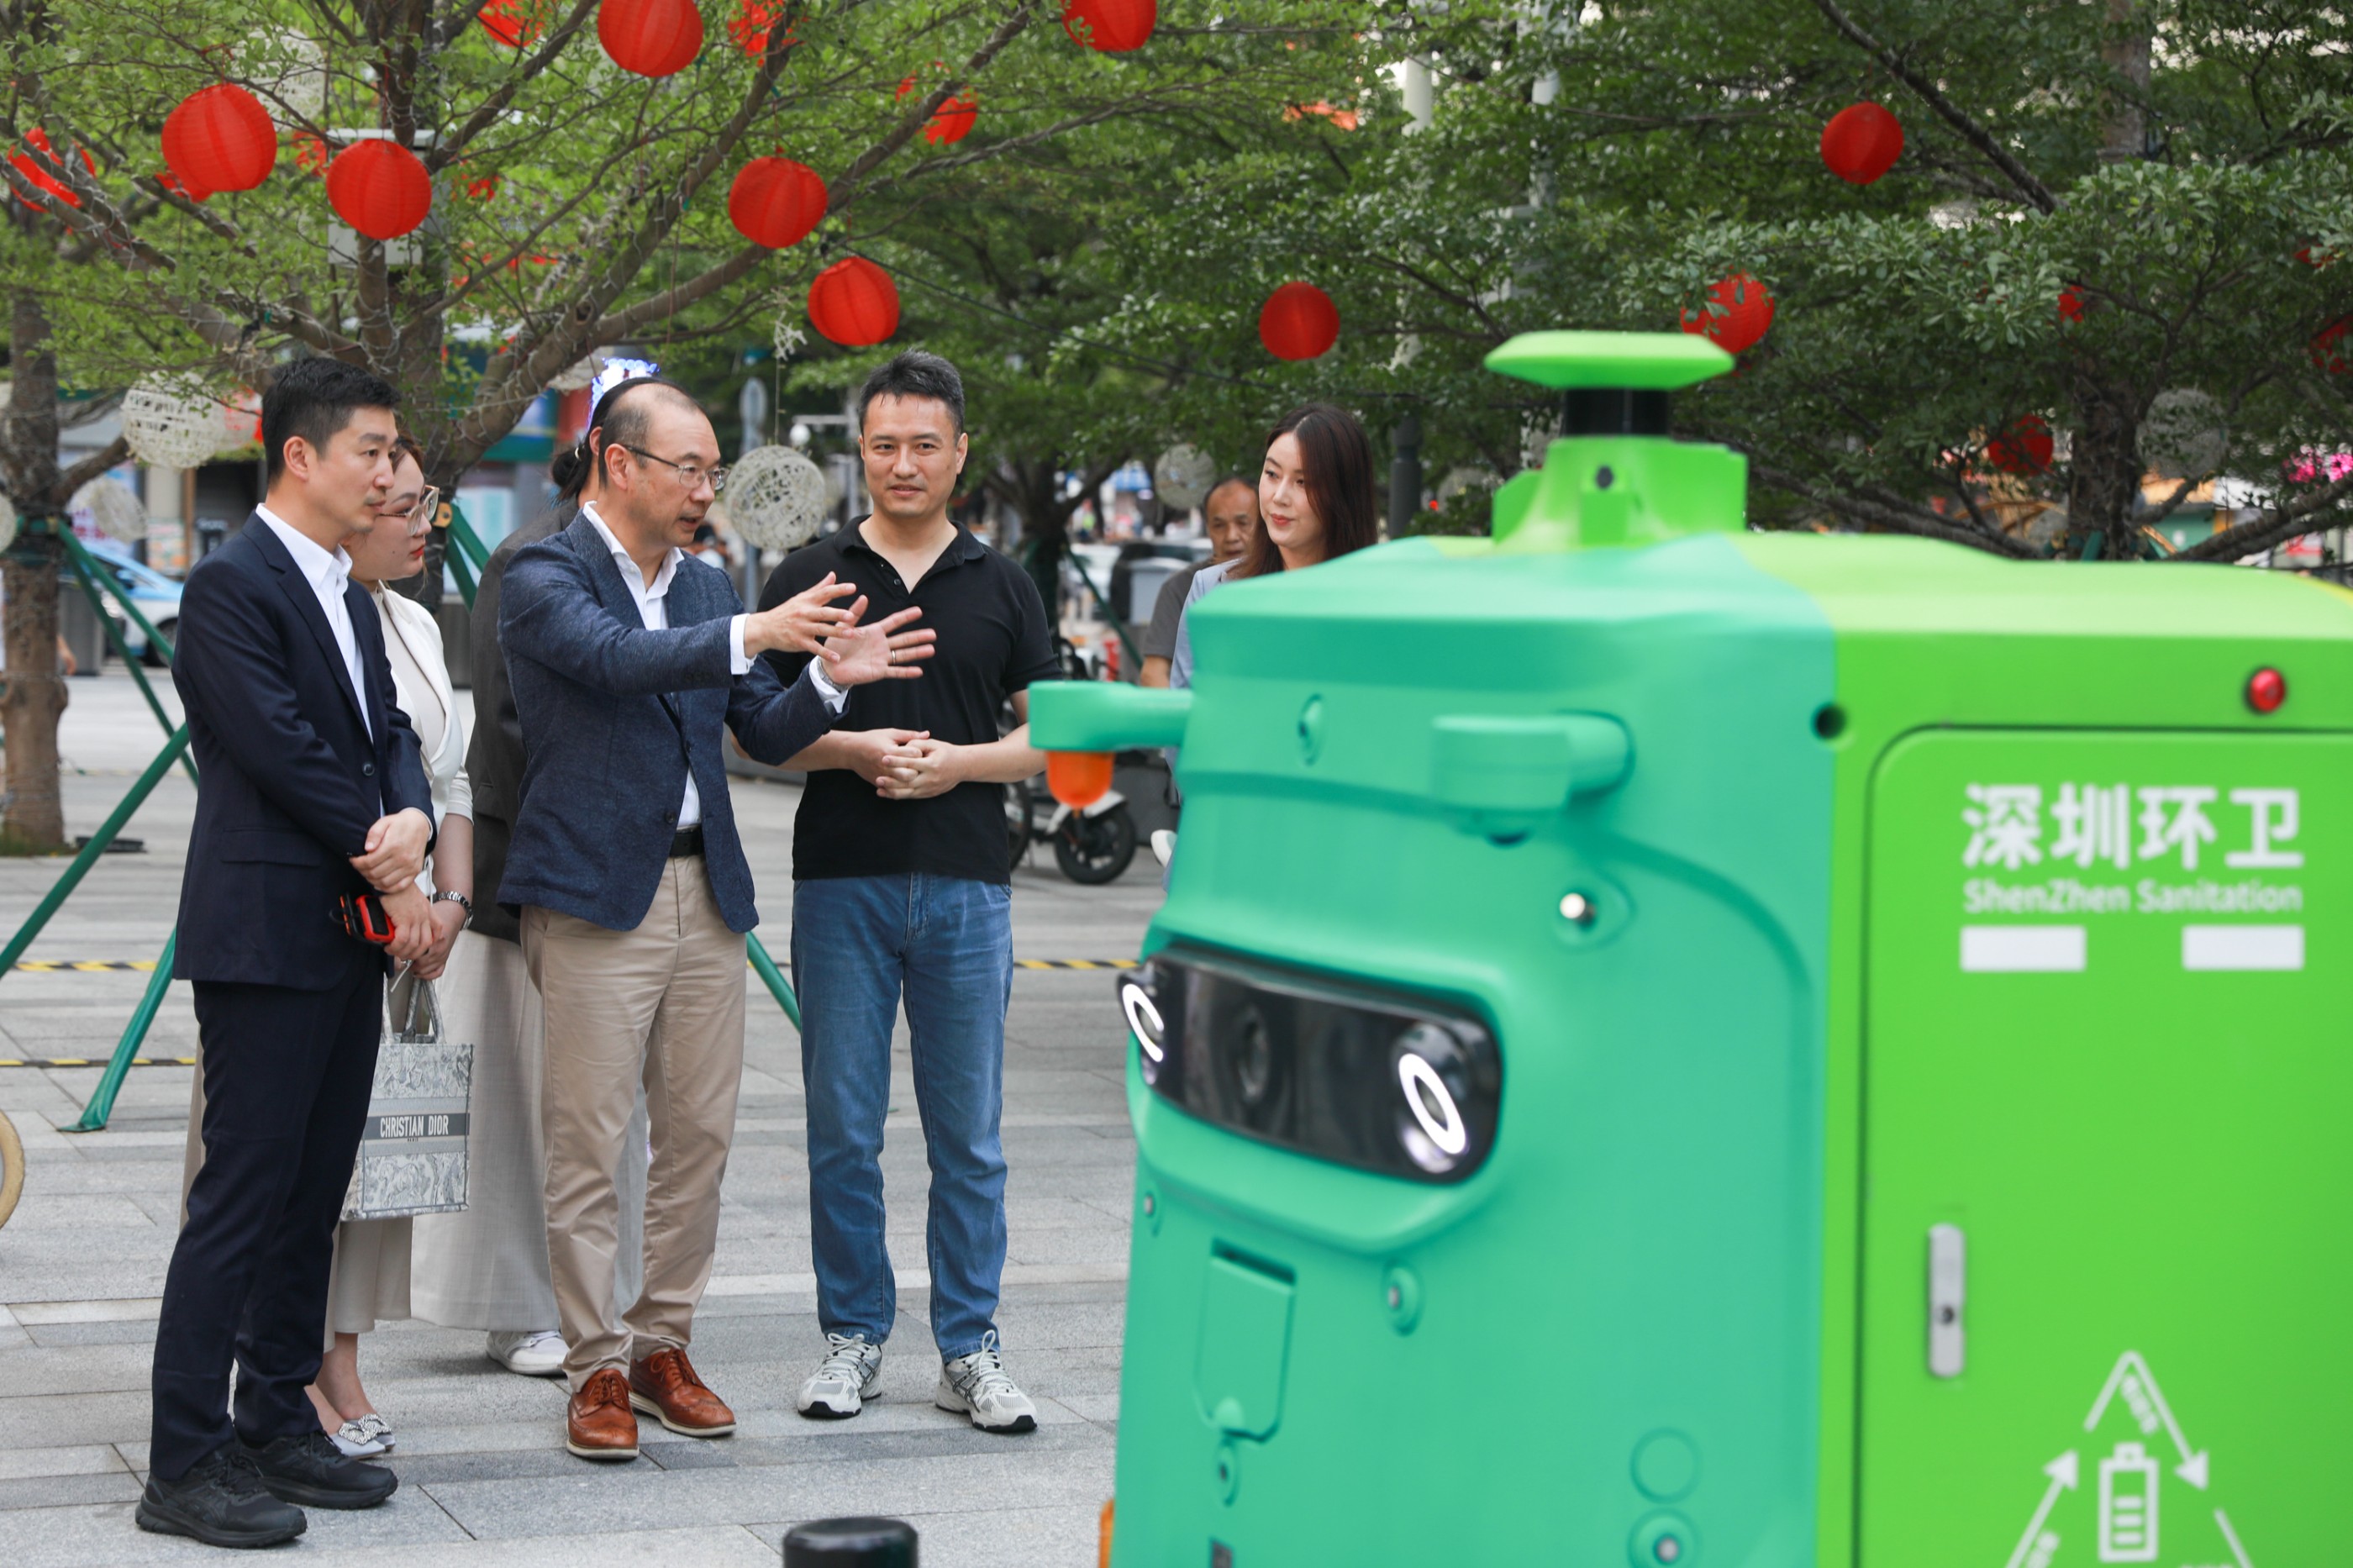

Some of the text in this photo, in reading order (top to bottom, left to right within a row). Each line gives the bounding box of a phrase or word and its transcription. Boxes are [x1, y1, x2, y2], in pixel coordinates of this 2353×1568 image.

[1961, 782, 2305, 871] 深圳环卫
[1962, 878, 2303, 913] ShenZhen Sanitation
[380, 1114, 449, 1138] CHRISTIAN DIOR
